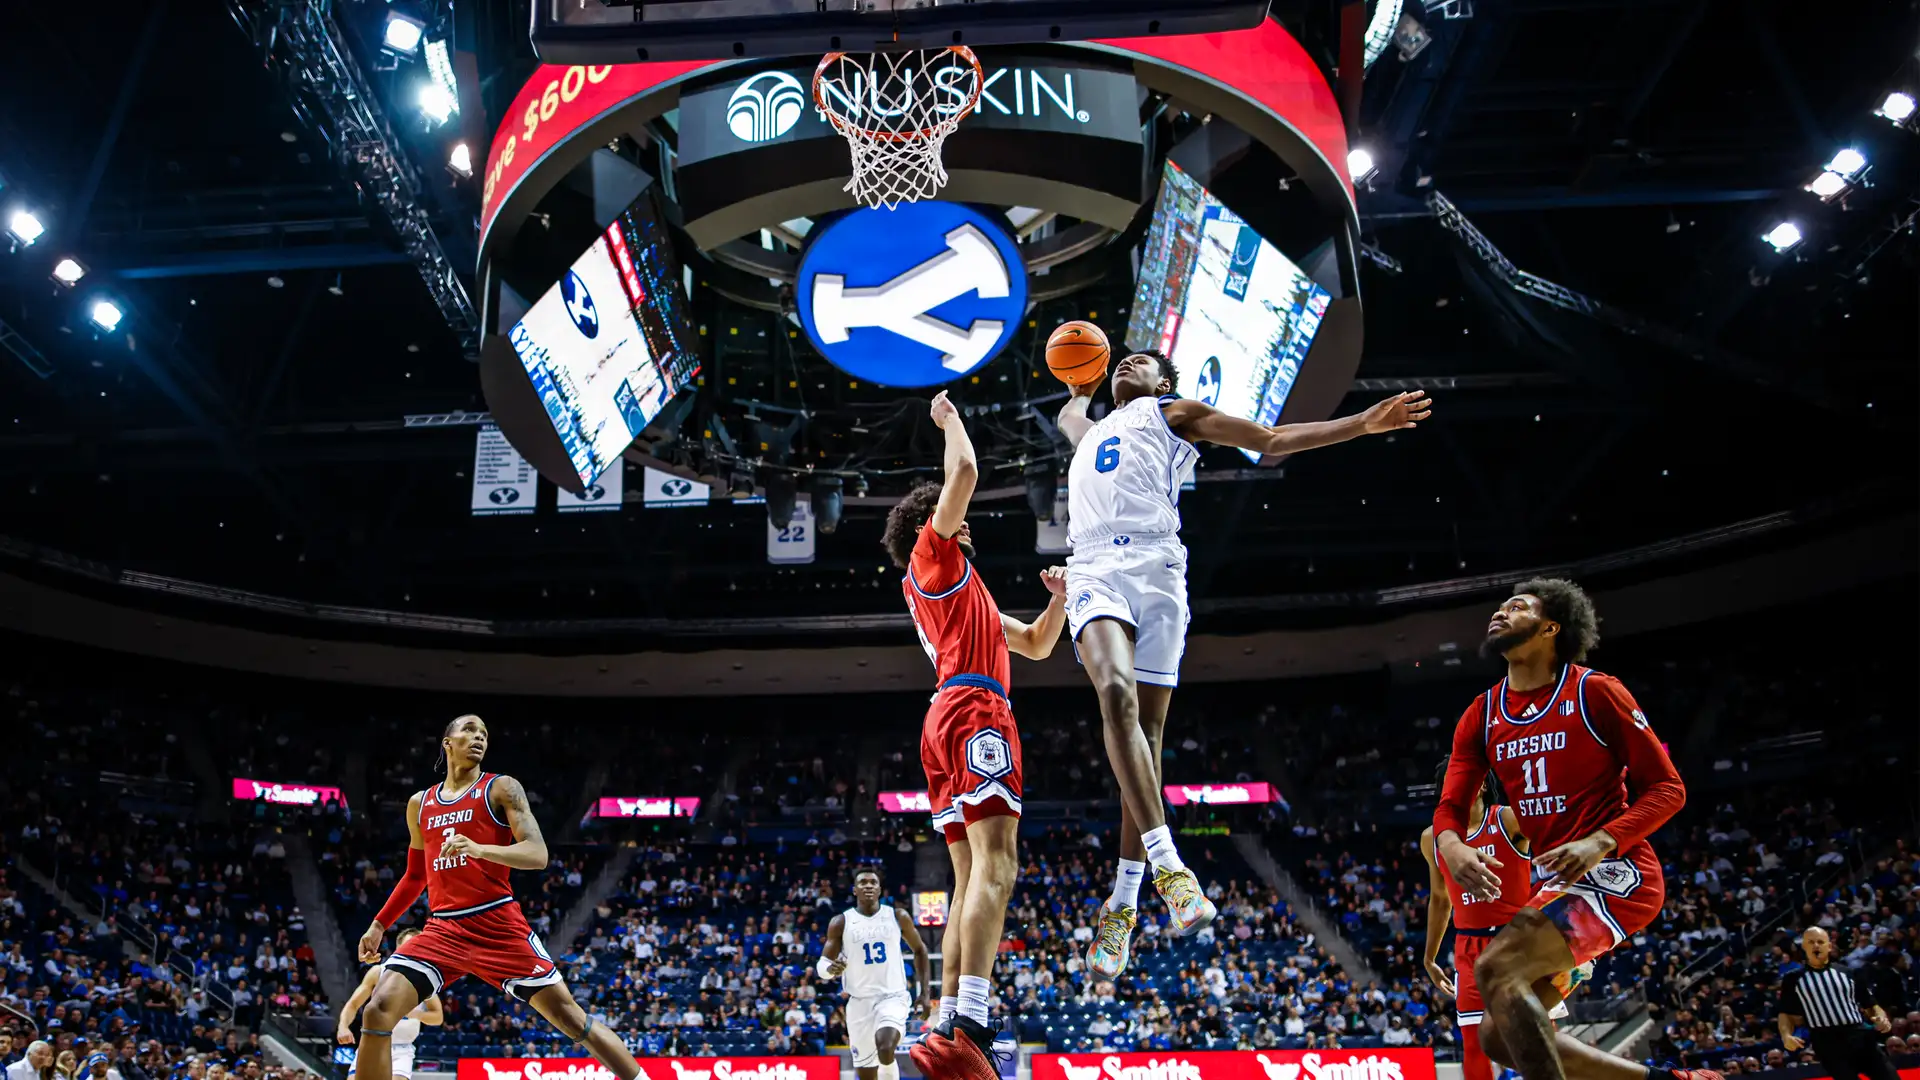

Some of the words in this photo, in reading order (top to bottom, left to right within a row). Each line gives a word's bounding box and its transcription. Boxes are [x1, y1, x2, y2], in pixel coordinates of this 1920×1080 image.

[820, 68, 912, 122] NU
[1095, 436, 1120, 473] 6
[777, 526, 804, 542] 22
[1496, 731, 1566, 761] FRESNO
[1522, 757, 1548, 794] 11
[1519, 795, 1567, 816] STATE
[427, 808, 474, 830] FRESNO
[433, 853, 467, 872] STATE
[918, 904, 945, 926] 25
[863, 941, 887, 964] 13
